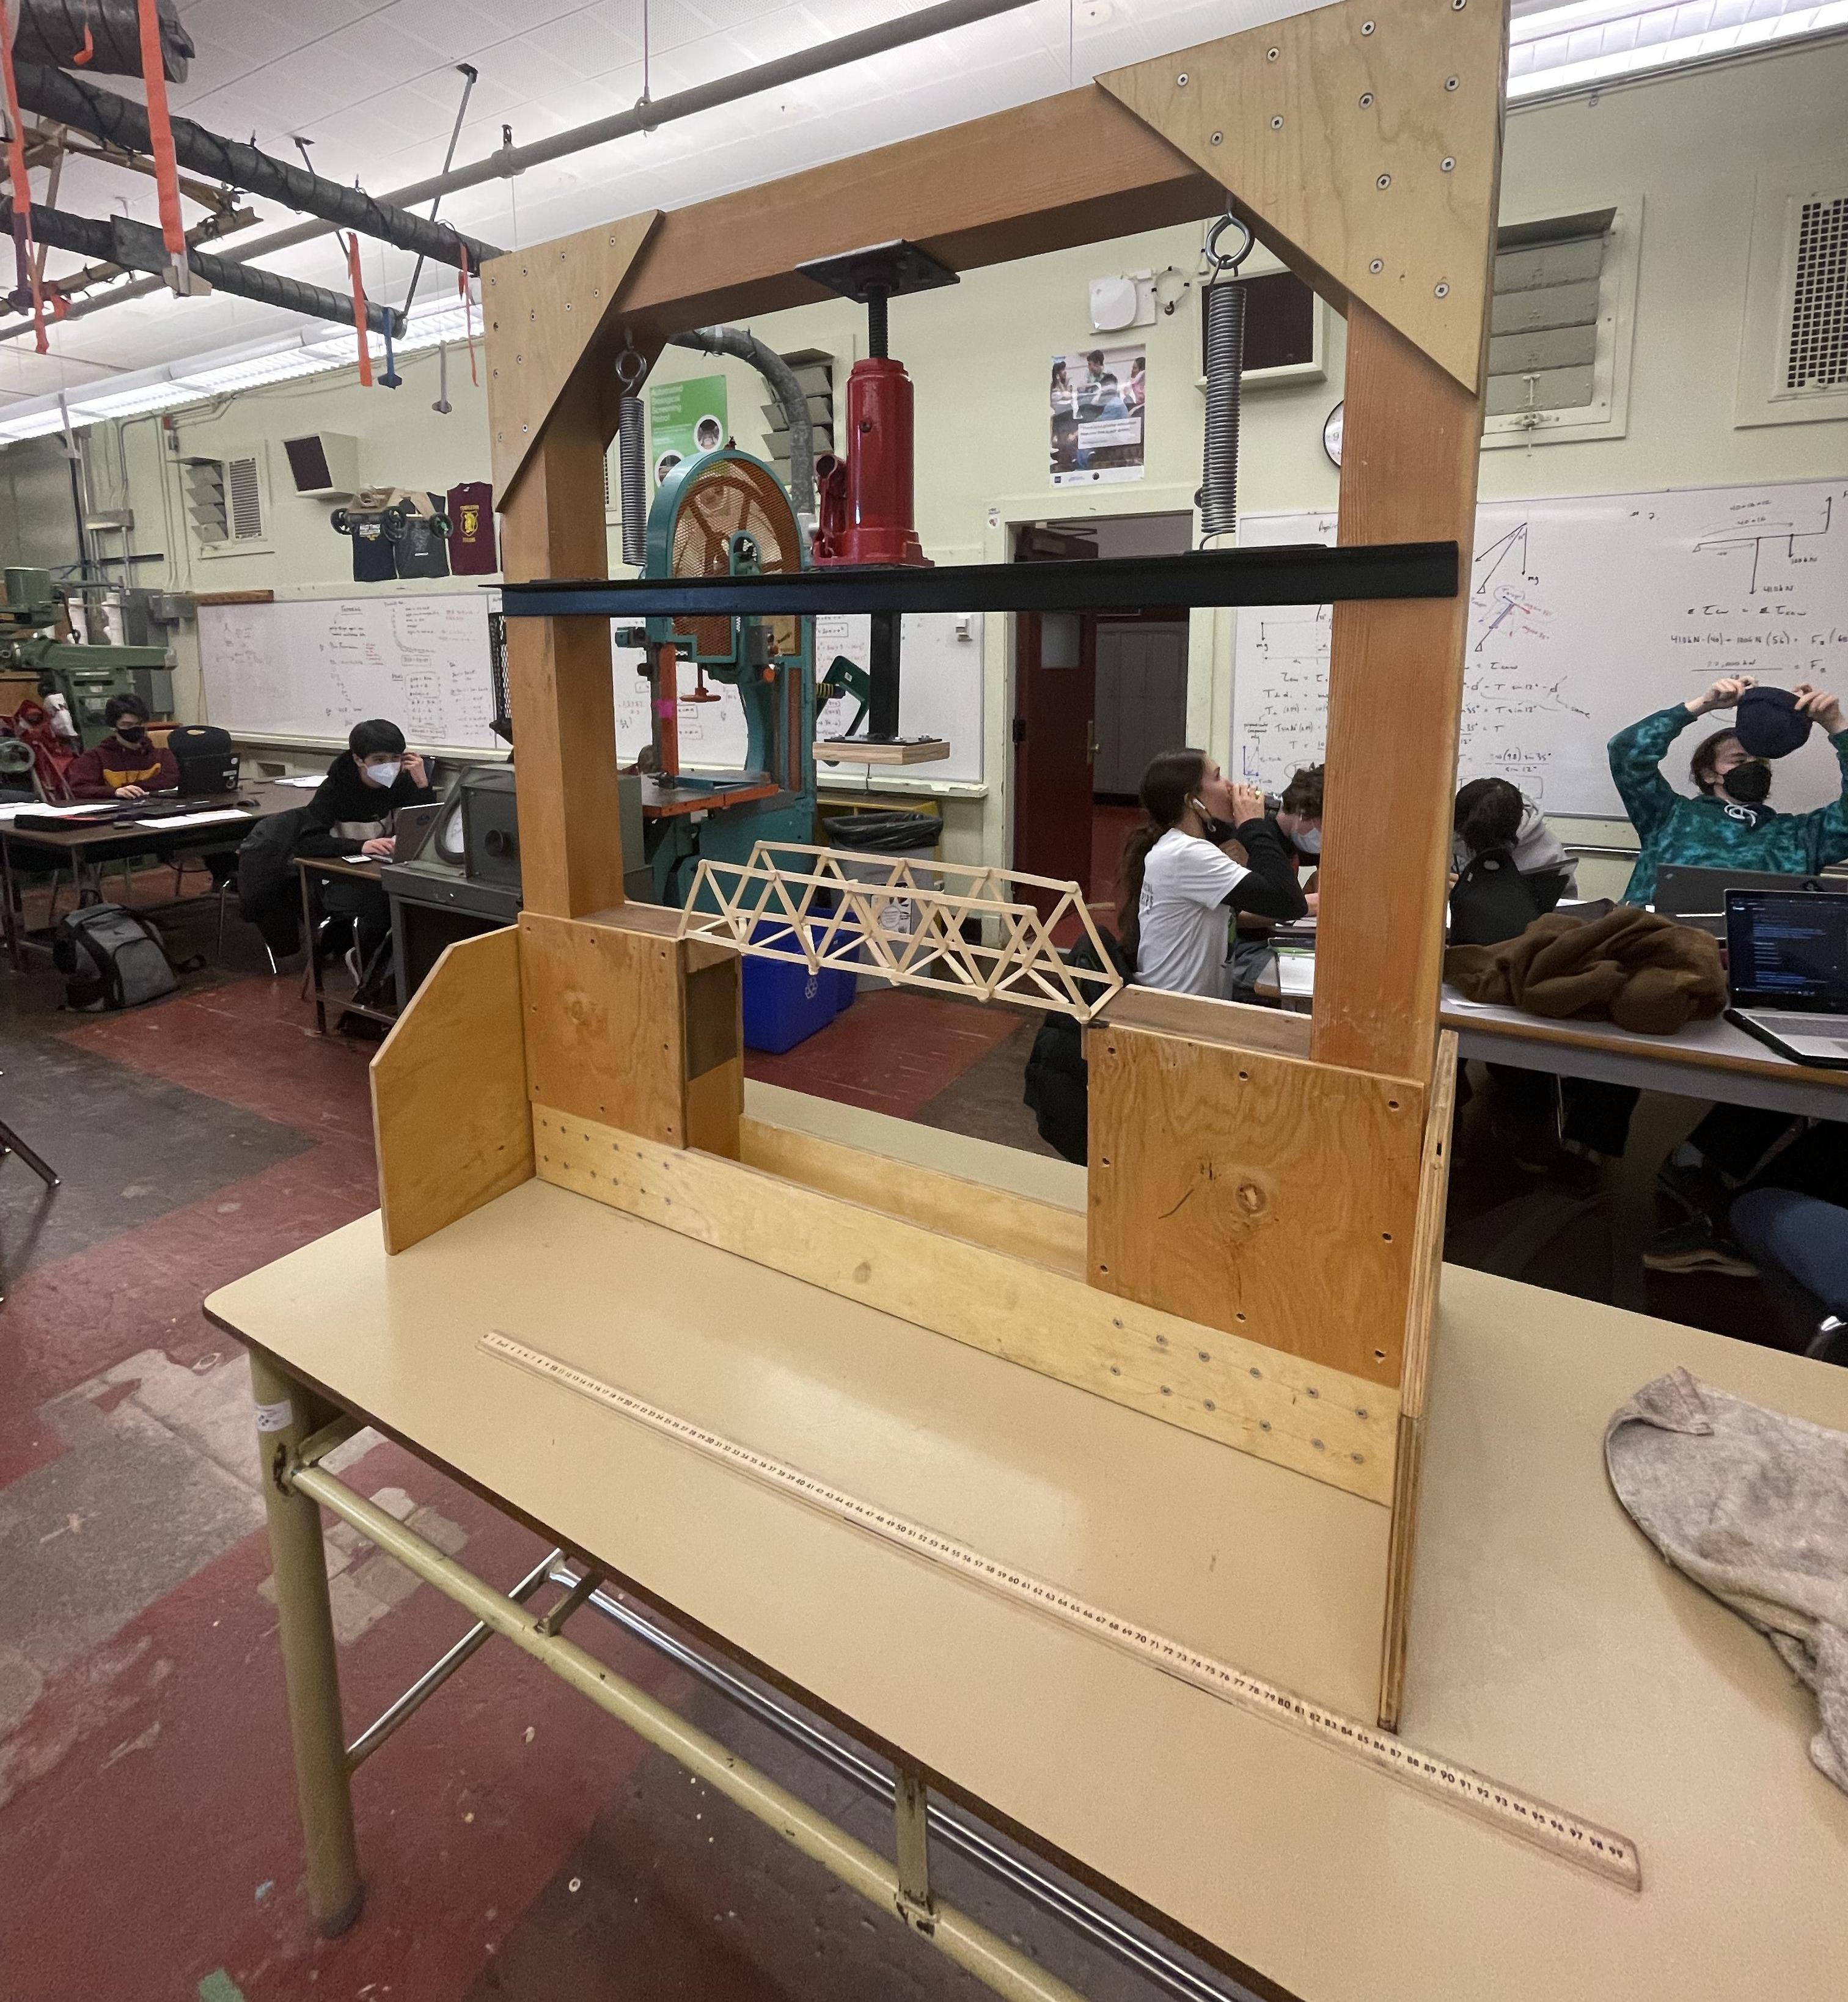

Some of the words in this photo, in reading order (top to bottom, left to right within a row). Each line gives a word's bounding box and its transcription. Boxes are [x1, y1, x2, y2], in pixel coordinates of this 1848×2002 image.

[1333, 431, 1340, 441] 9
[1046, 1593, 1055, 1601] 63
[1135, 1633, 1146, 1643] 70
[1150, 1640, 1159, 1649] 71
[1164, 1646, 1173, 1655] 72
[1177, 1652, 1187, 1662] 73
[1191, 1659, 1201, 1667] 74
[1205, 1665, 1215, 1674] 75
[1220, 1671, 1230, 1681] 76
[1234, 1678, 1245, 1687] 77
[1249, 1685, 1260, 1695] 78
[1265, 1692, 1275, 1701] 79
[1278, 1697, 1291, 1709] 80
[1295, 1706, 1304, 1715] 81
[1310, 1712, 1321, 1723] 82
[1325, 1719, 1338, 1731] 83
[1341, 1726, 1353, 1736] 84
[1358, 1734, 1369, 1744] 85
[1374, 1741, 1385, 1751] 86
[1390, 1748, 1401, 1758] 87
[1407, 1756, 1419, 1767] 88
[1425, 1764, 1436, 1773] 89
[1440, 1770, 1455, 1783] 90
[1460, 1780, 1470, 1791] 91
[1477, 1787, 1489, 1798] 92
[1495, 1795, 1508, 1806] 93
[1514, 1803, 1526, 1815] 94
[1532, 1811, 1545, 1824] 95
[1551, 1821, 1564, 1832] 96
[1570, 1828, 1583, 1840] 97
[1590, 1837, 1603, 1850] 98
[1609, 1846, 1623, 1858] 99
